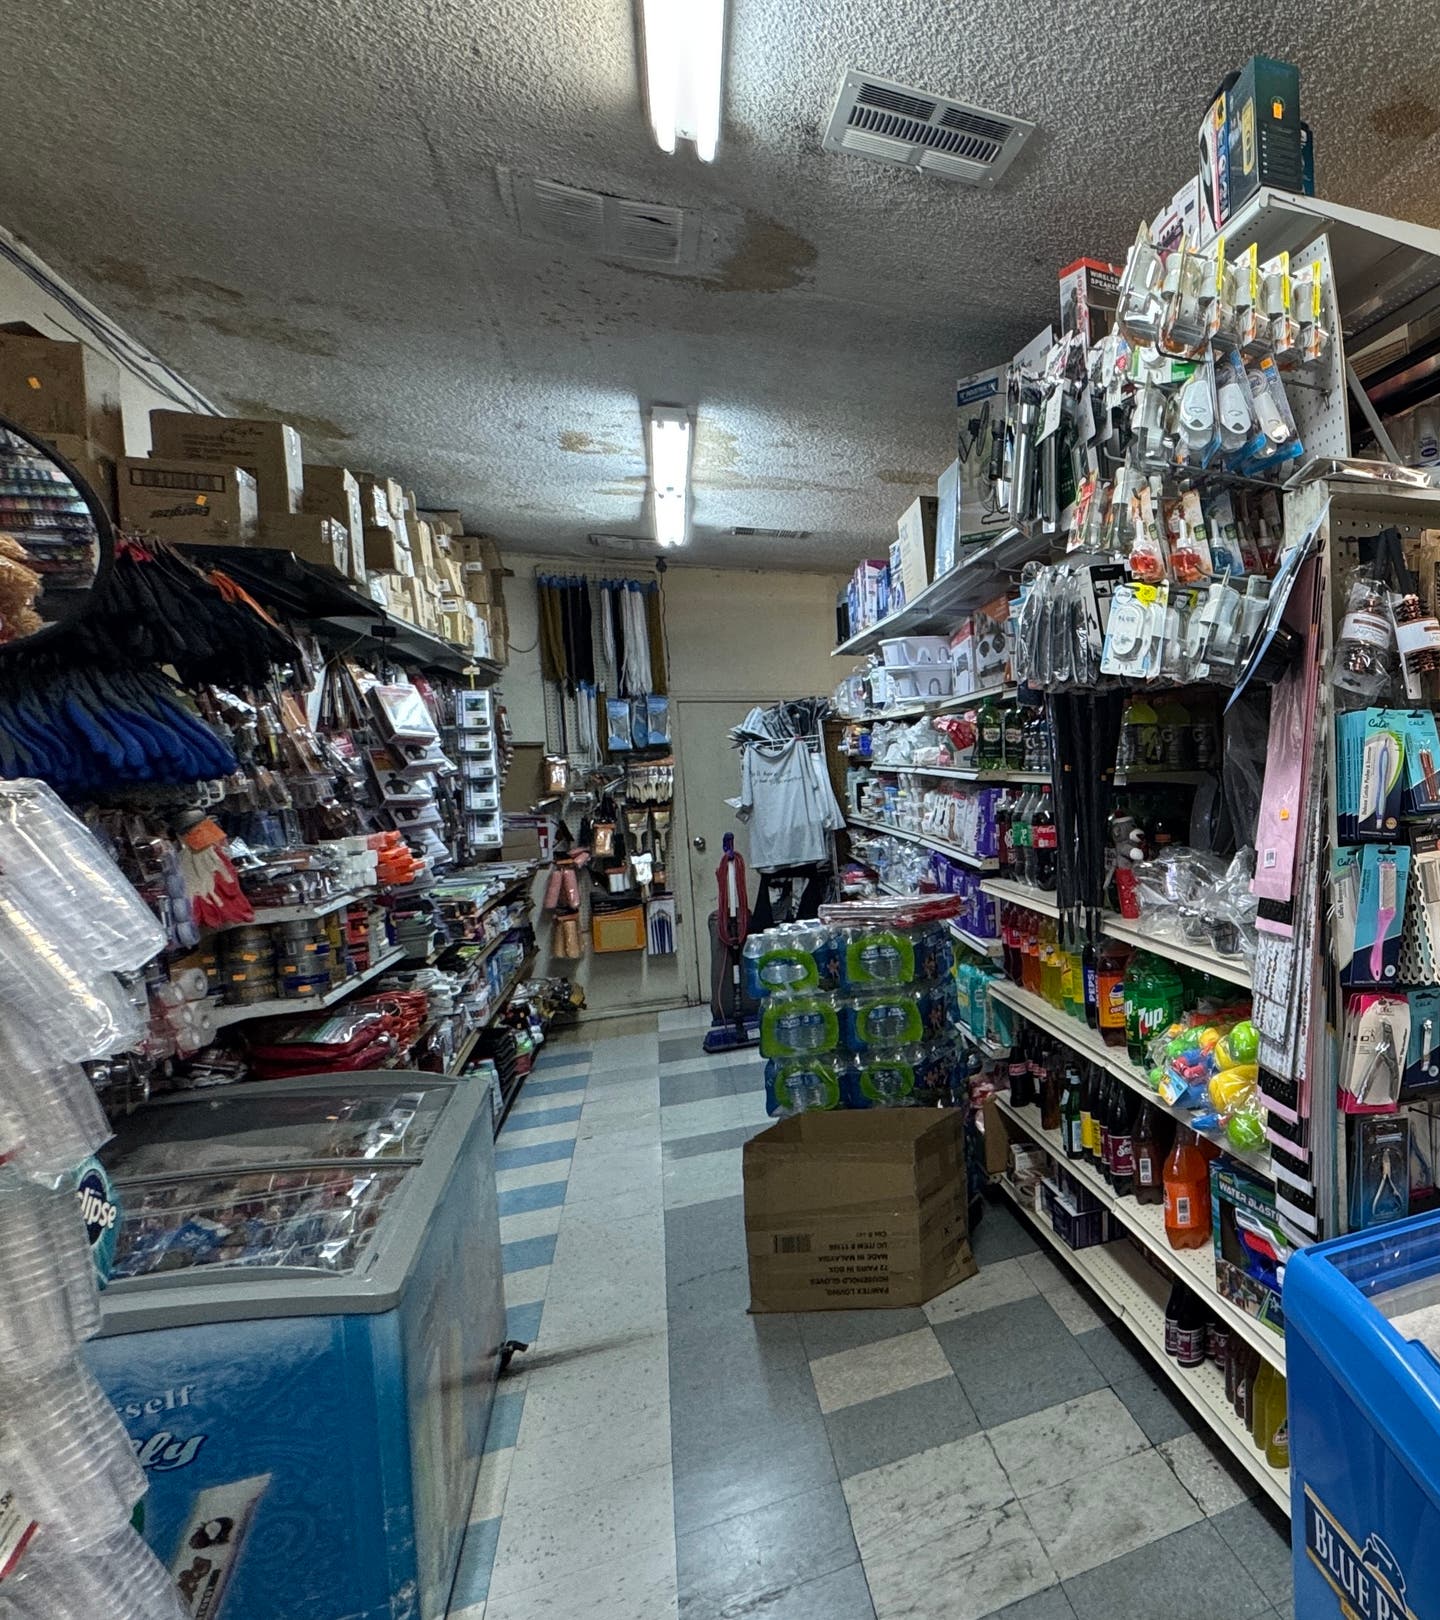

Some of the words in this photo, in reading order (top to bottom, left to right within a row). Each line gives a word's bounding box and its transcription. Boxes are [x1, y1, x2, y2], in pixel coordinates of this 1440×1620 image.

[1138, 1007, 1164, 1034] 7up
[1219, 1181, 1247, 1203] WATER
[1313, 1508, 1372, 1618] BLUE
